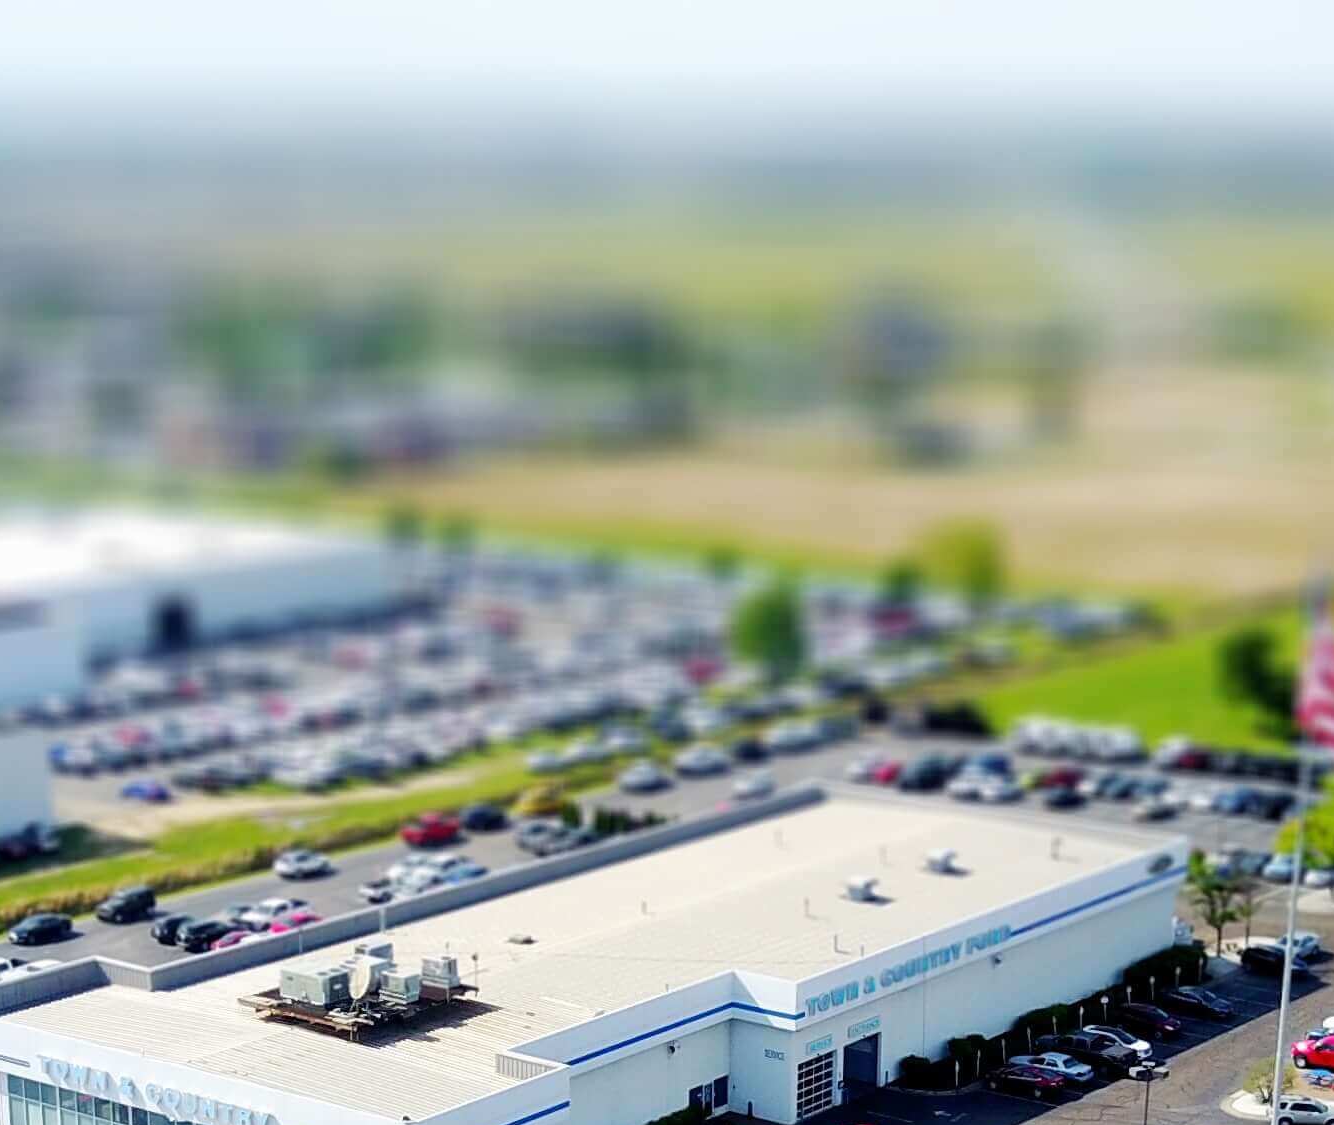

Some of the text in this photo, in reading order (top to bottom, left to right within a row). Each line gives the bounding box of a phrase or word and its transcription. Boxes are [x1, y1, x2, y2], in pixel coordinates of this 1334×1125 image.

[805, 980, 859, 1017] TOWN
[863, 974, 875, 995] &
[880, 942, 962, 988] COUNTRY
[38, 1055, 110, 1091] TOWN
